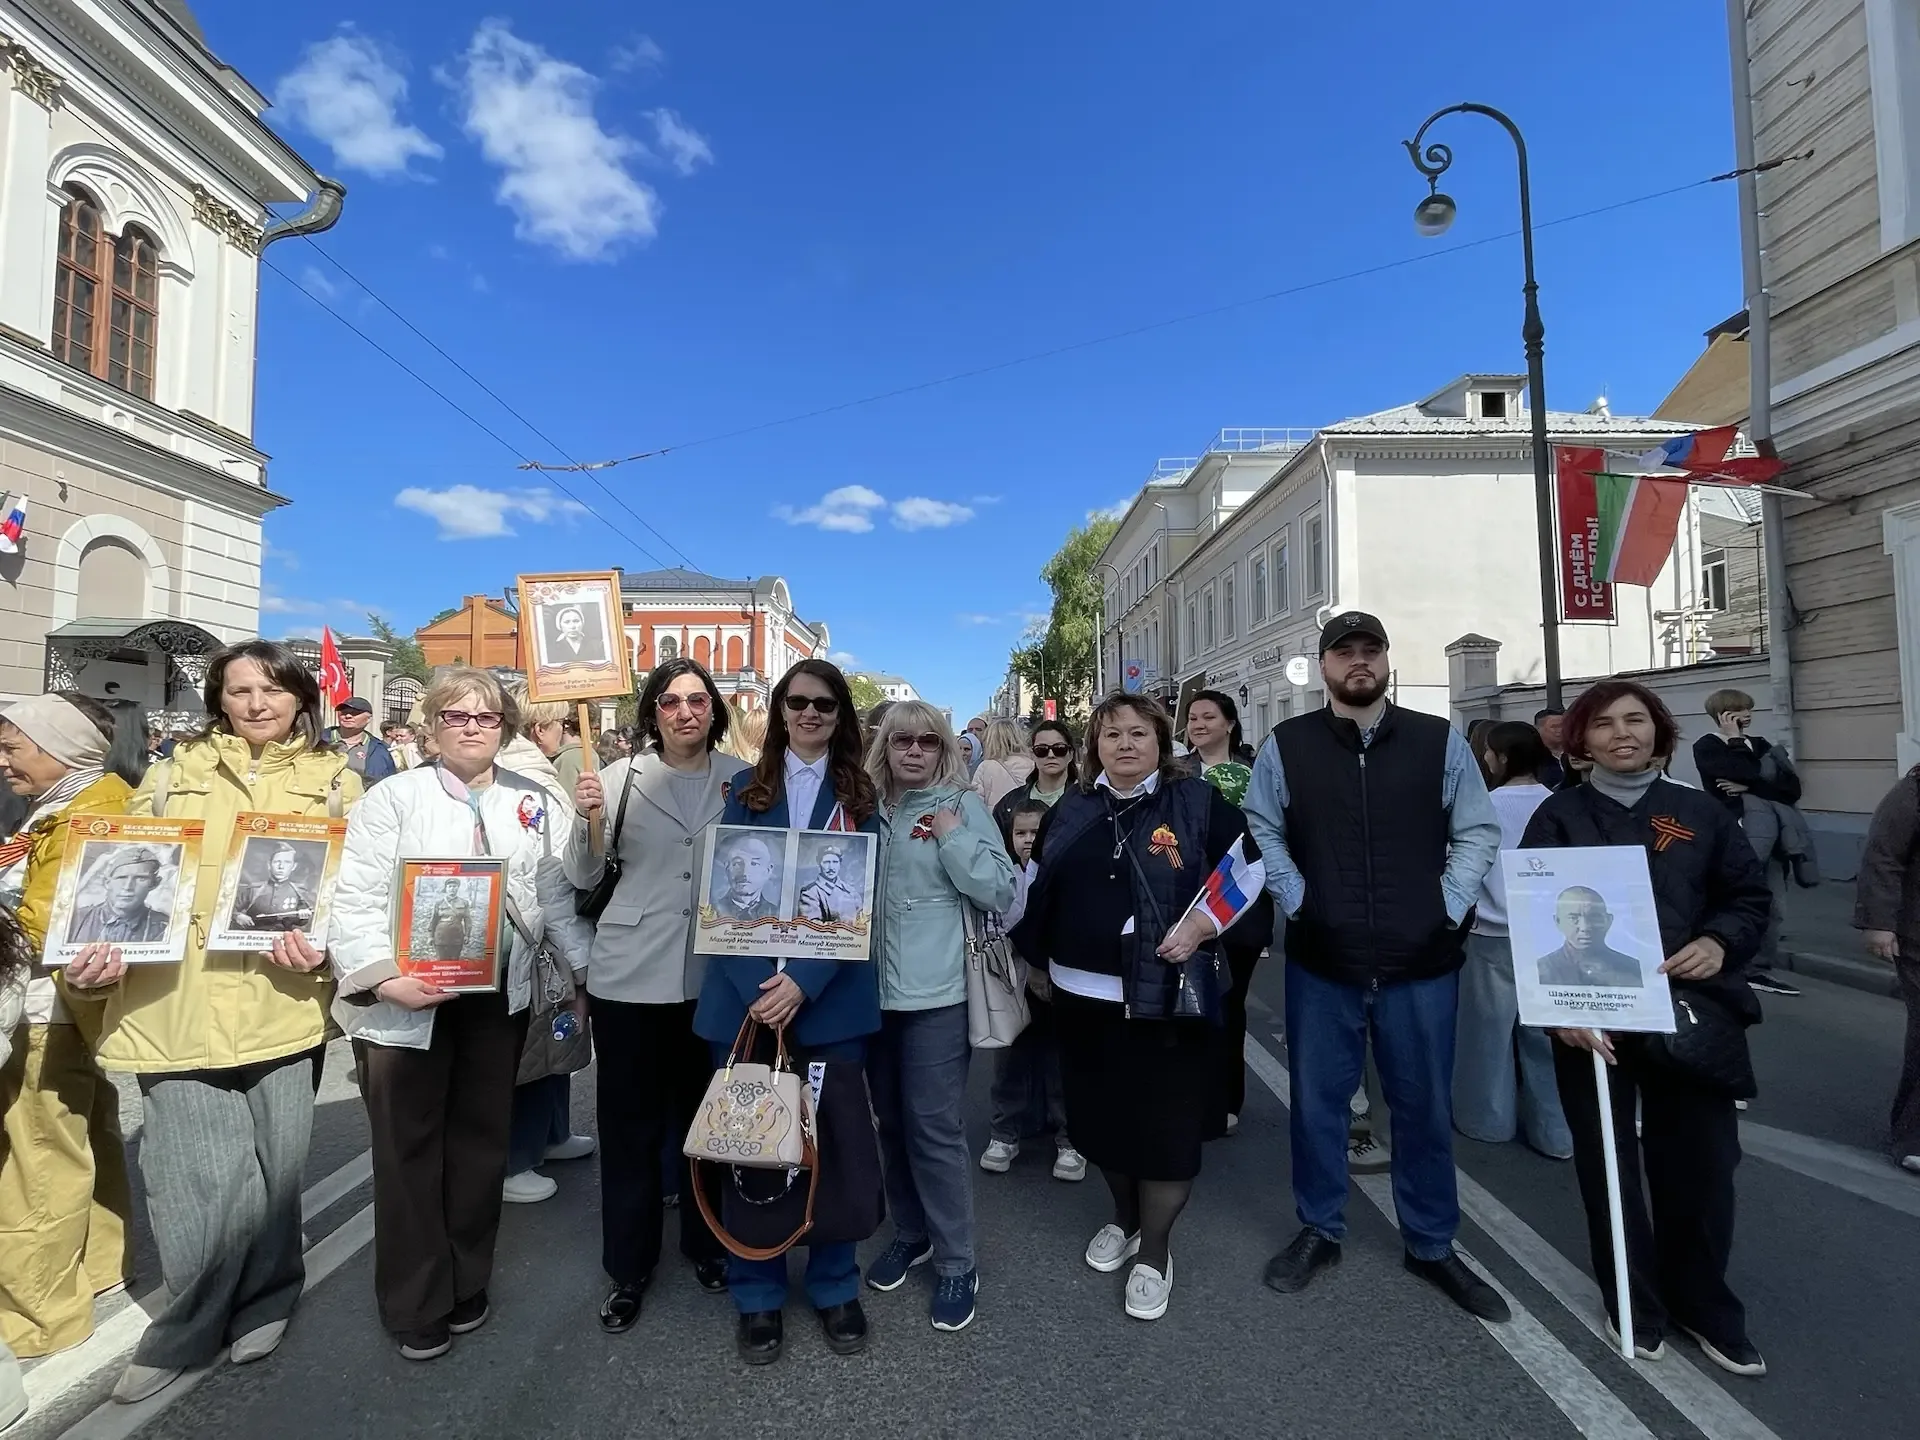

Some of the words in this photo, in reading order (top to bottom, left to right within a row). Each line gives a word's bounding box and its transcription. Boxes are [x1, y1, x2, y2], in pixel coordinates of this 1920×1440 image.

[1569, 533, 1589, 589] ДНЁМ
[1575, 594, 1588, 607] С
[797, 940, 824, 948] Махмуд
[1548, 990, 1593, 999] Шайхиев
[1595, 991, 1637, 1000] Зиятдин
[1554, 999, 1634, 1009] Шайхутдинович
